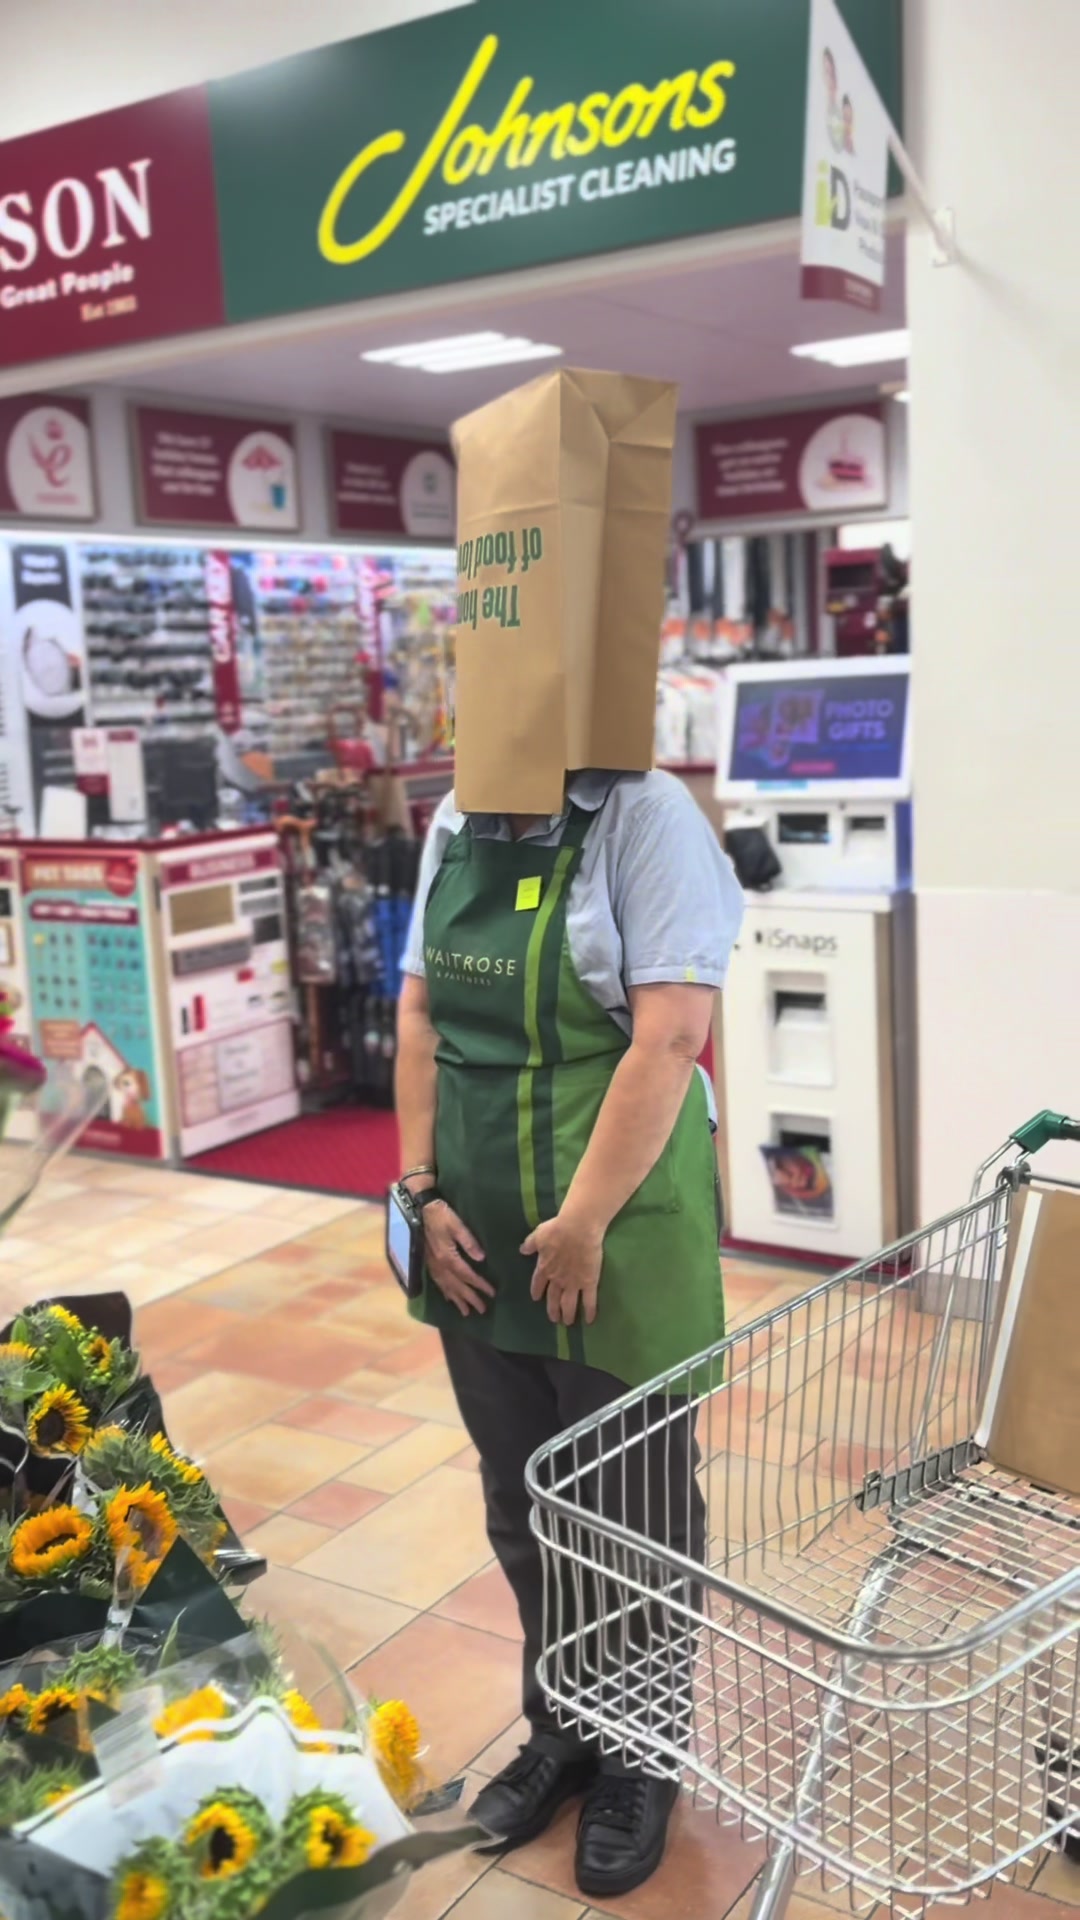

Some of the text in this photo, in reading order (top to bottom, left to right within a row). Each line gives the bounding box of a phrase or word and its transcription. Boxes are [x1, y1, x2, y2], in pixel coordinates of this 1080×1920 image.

[318, 34, 735, 264] Johnsons
[423, 138, 736, 236] SPECIALIST CLEANING
[61, 261, 136, 296] People
[473, 531, 517, 576] food
[521, 527, 543, 573] of
[482, 585, 520, 628] The
[825, 699, 893, 721] PHOTO
[828, 720, 887, 741] GIFTS
[425, 944, 517, 976] WAITROSE
